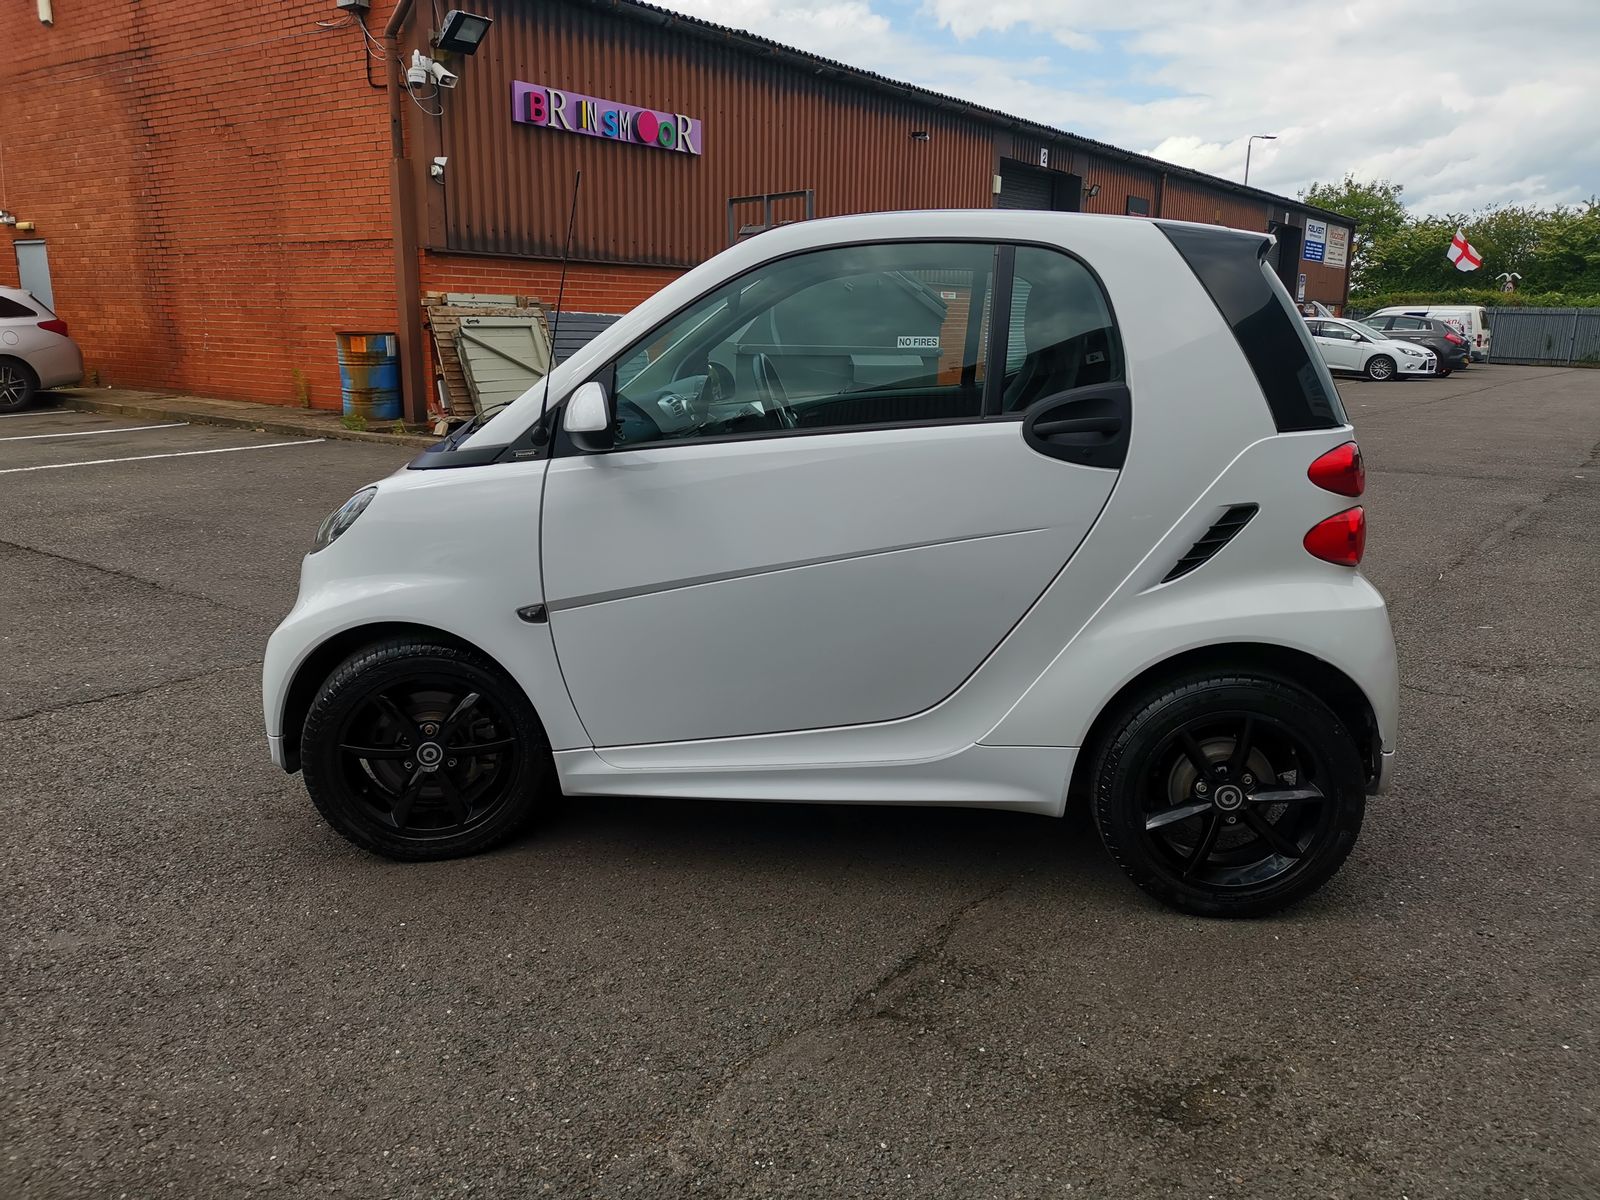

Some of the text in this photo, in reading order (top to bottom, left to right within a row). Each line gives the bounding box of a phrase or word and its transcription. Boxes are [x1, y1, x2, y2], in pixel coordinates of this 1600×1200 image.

[1042, 151, 1047, 164] 2
[898, 337, 937, 346] NO FIRES
